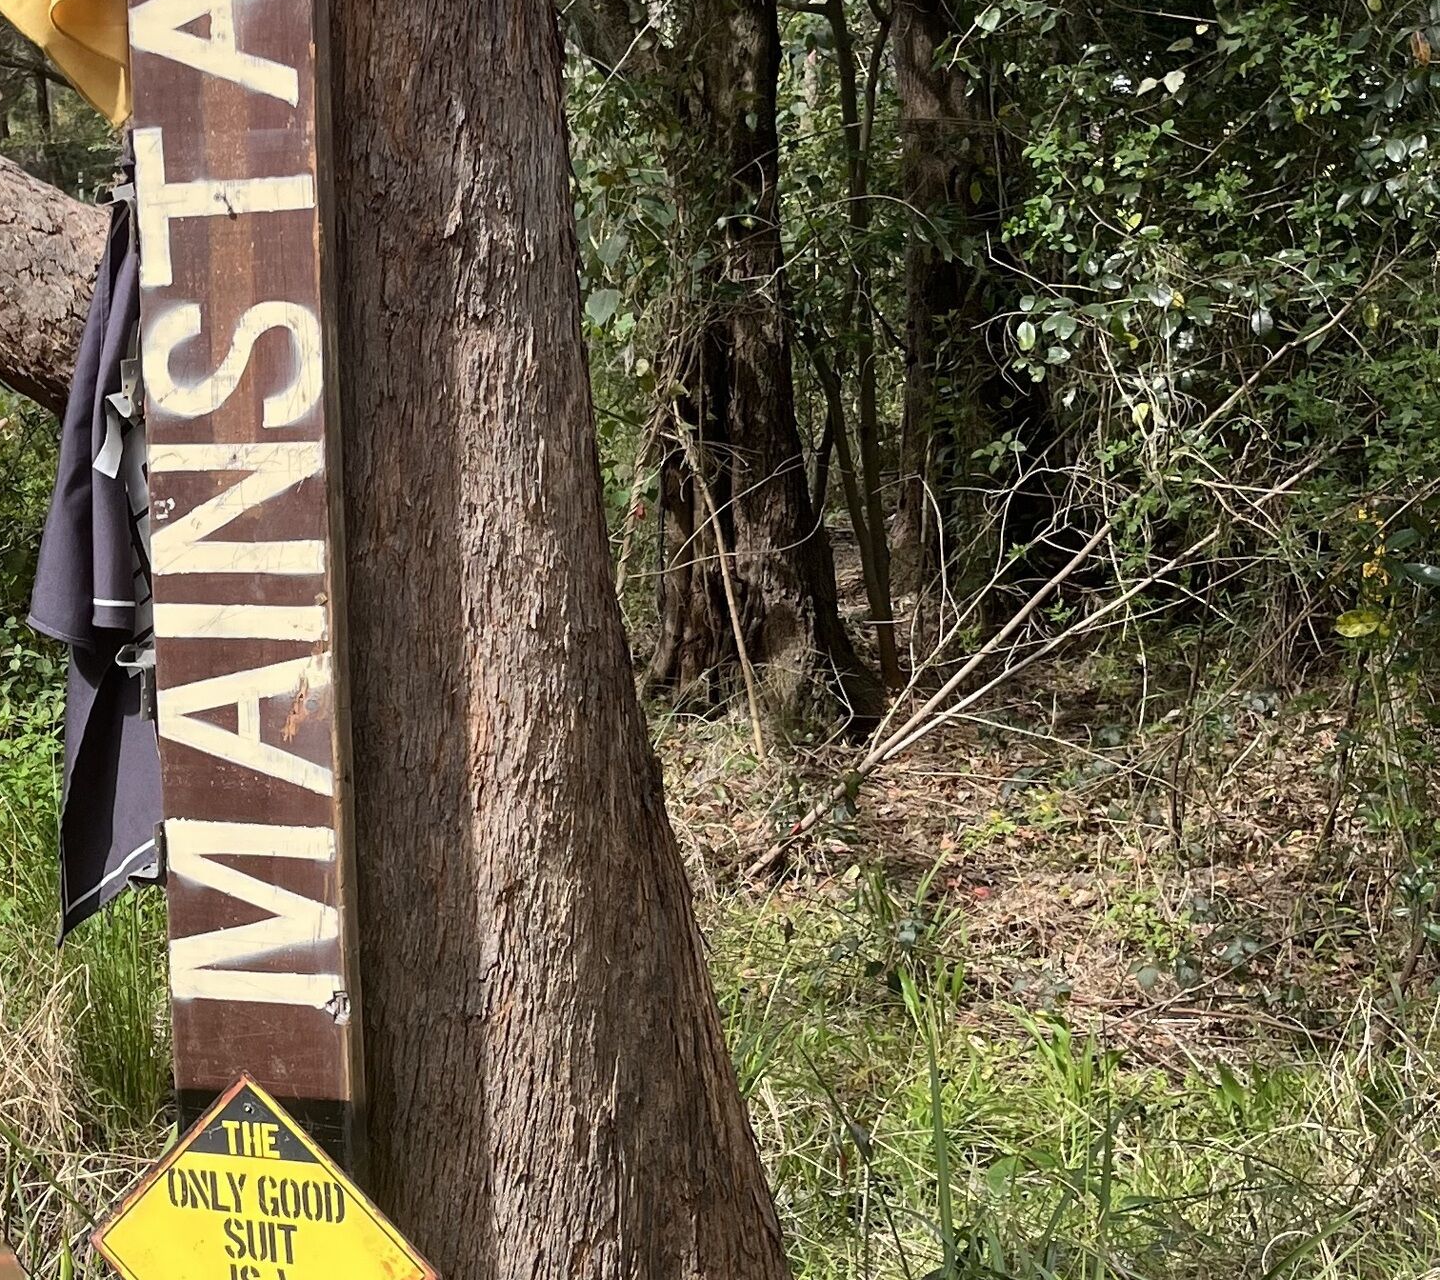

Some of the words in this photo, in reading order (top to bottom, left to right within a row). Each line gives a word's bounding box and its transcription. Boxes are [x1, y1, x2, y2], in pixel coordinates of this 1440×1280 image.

[221, 1120, 280, 1160] THE
[166, 1168, 247, 1214] ONLY
[258, 1174, 346, 1224] GOOD
[224, 1218, 298, 1265] SUIT
